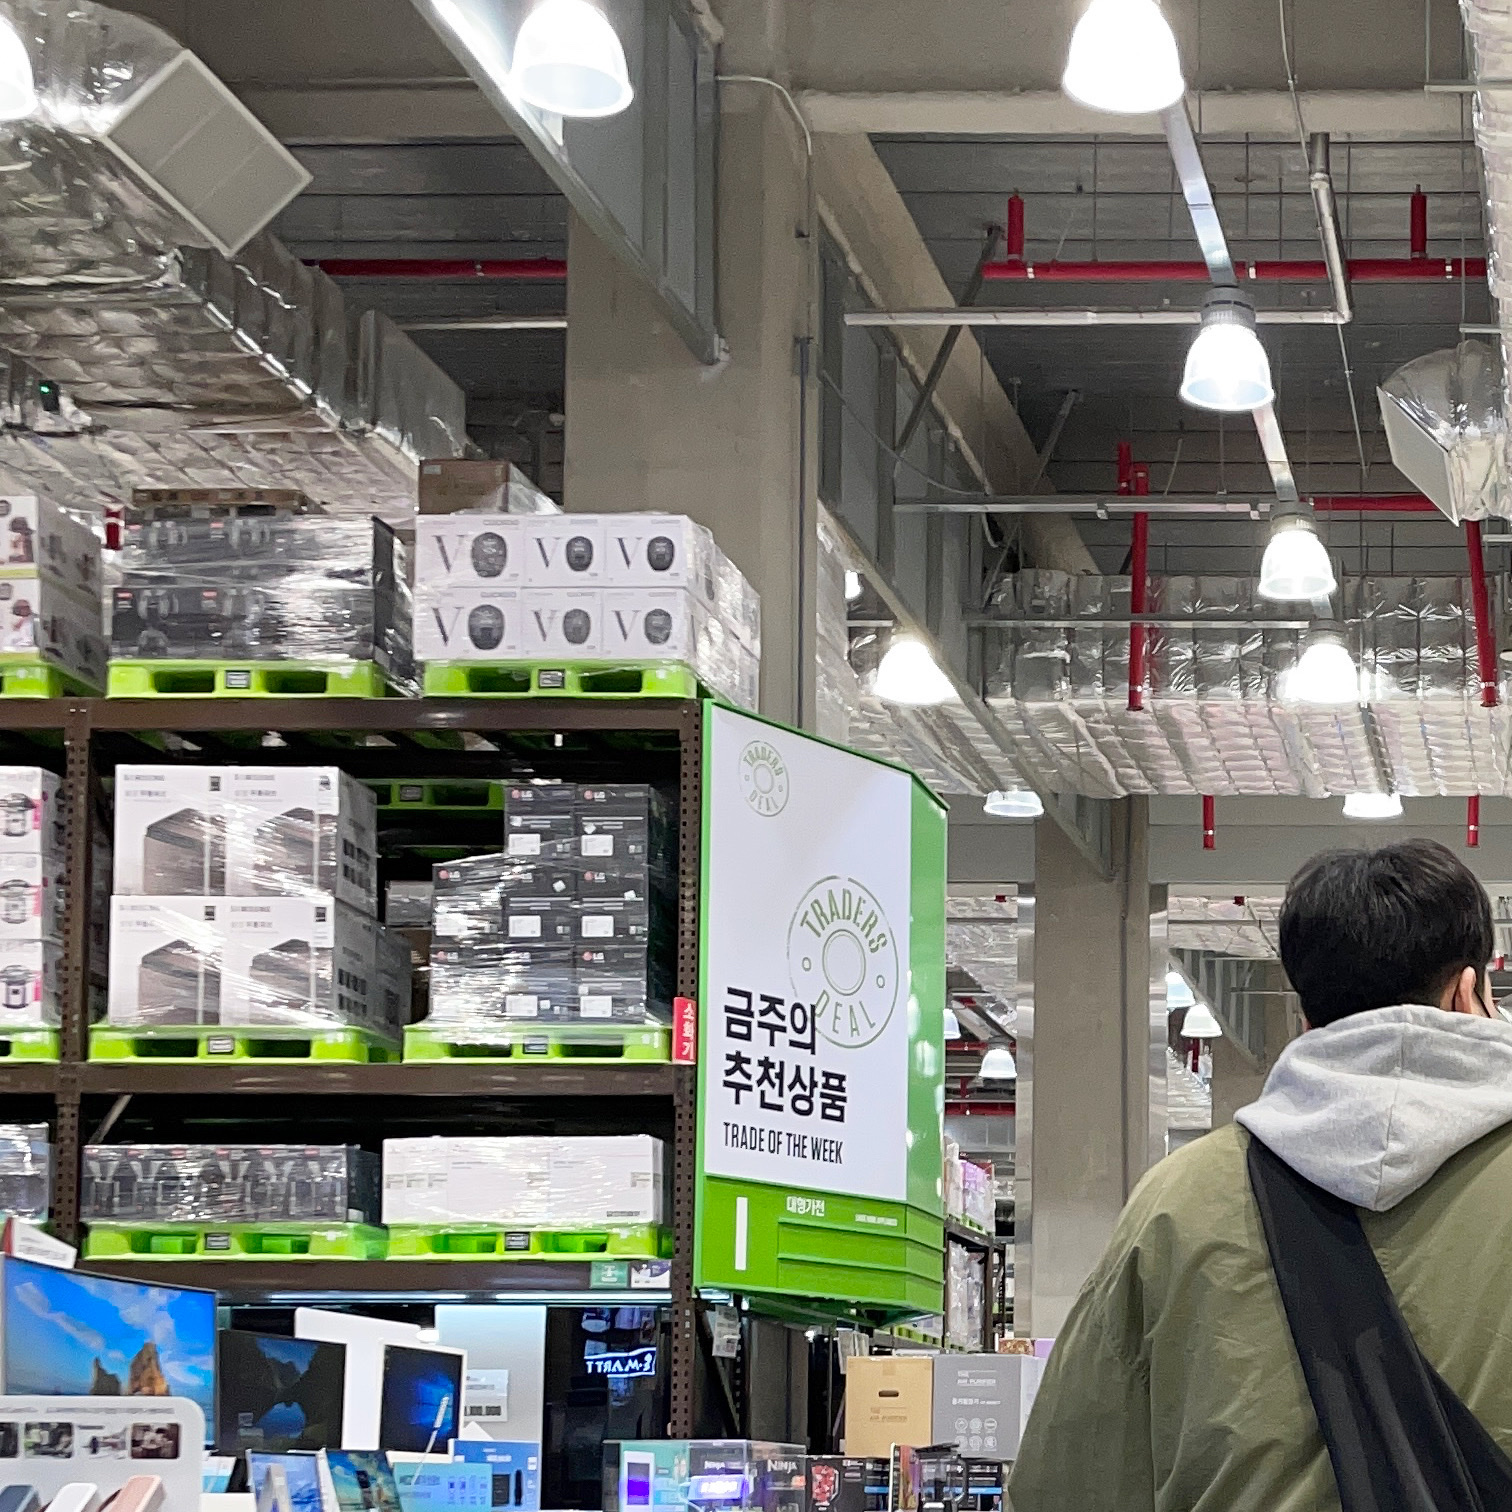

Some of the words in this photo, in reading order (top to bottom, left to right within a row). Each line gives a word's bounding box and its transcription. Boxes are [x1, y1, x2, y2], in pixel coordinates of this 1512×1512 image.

[800, 888, 888, 953] TRADERS
[724, 987, 816, 1055] 금주의
[815, 989, 876, 1037] DEAL
[723, 1050, 847, 1123] 추천상품
[723, 1122, 765, 1153] TRADE
[768, 1128, 782, 1155] OF
[786, 1133, 807, 1159] THE
[811, 1136, 843, 1164] WEEK
[735, 1197, 748, 1271] 1
[787, 1196, 825, 1217] 대형가전
[767, 1459, 798, 1474] NINJA
